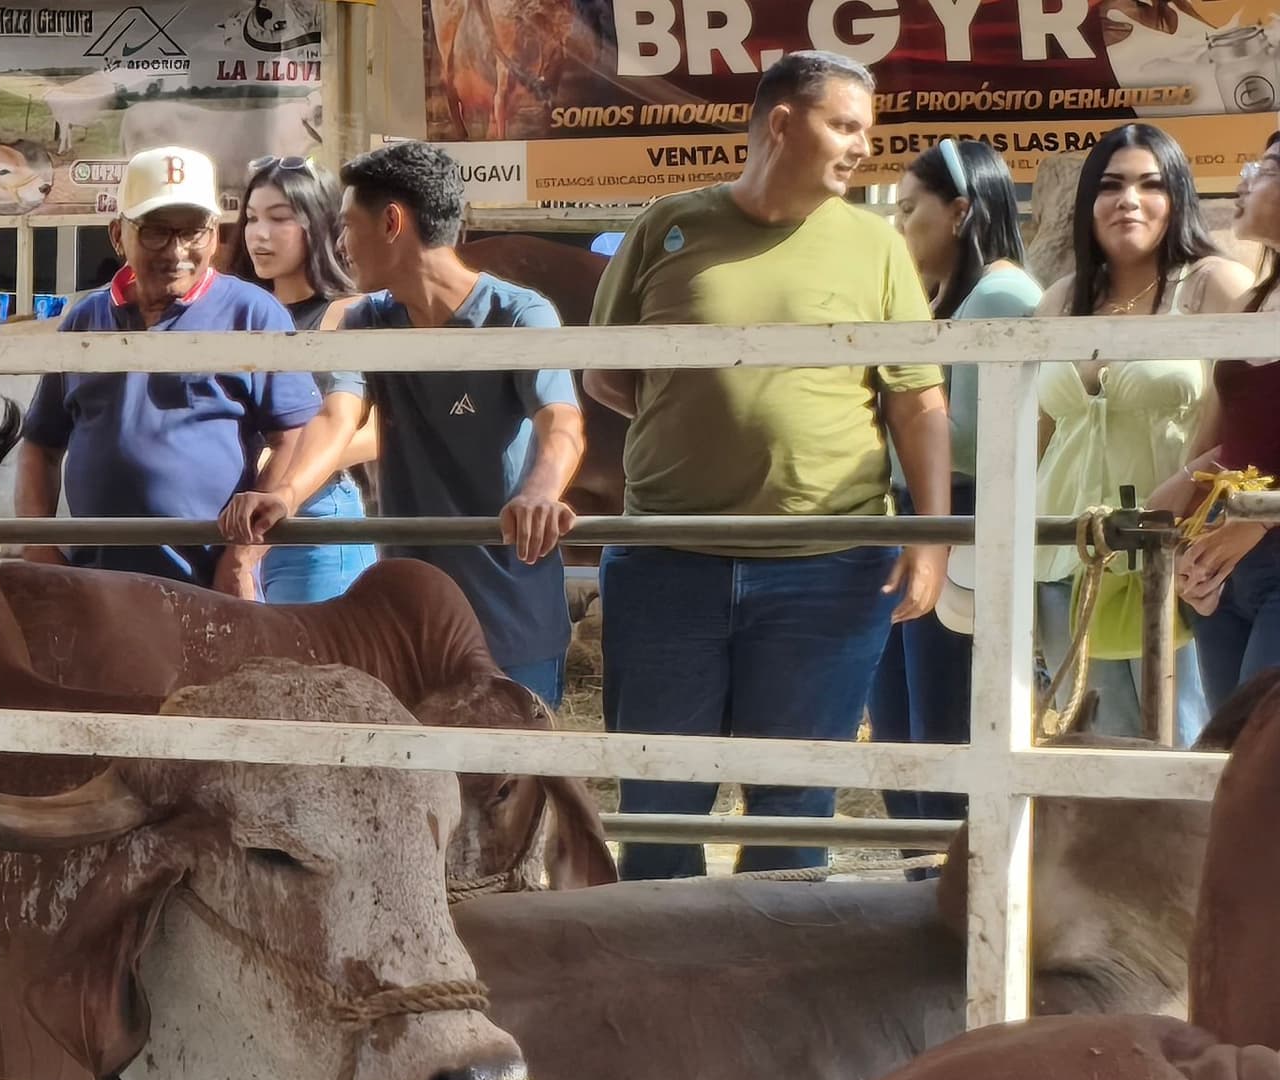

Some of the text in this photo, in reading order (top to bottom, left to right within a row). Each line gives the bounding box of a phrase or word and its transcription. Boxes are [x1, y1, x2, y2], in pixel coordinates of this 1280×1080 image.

[217, 60, 247, 81] LA
[551, 105, 634, 129] SOMOS
[640, 103, 753, 126] INNOVACI
[916, 81, 1043, 112] PROPÓSITO
[647, 145, 729, 167] VENTA
[890, 134, 921, 154] DE
[1013, 132, 1059, 151] LAS
[161, 155, 185, 185] B
[456, 165, 521, 183] UGAVI
[598, 174, 665, 186] UBICADOS
